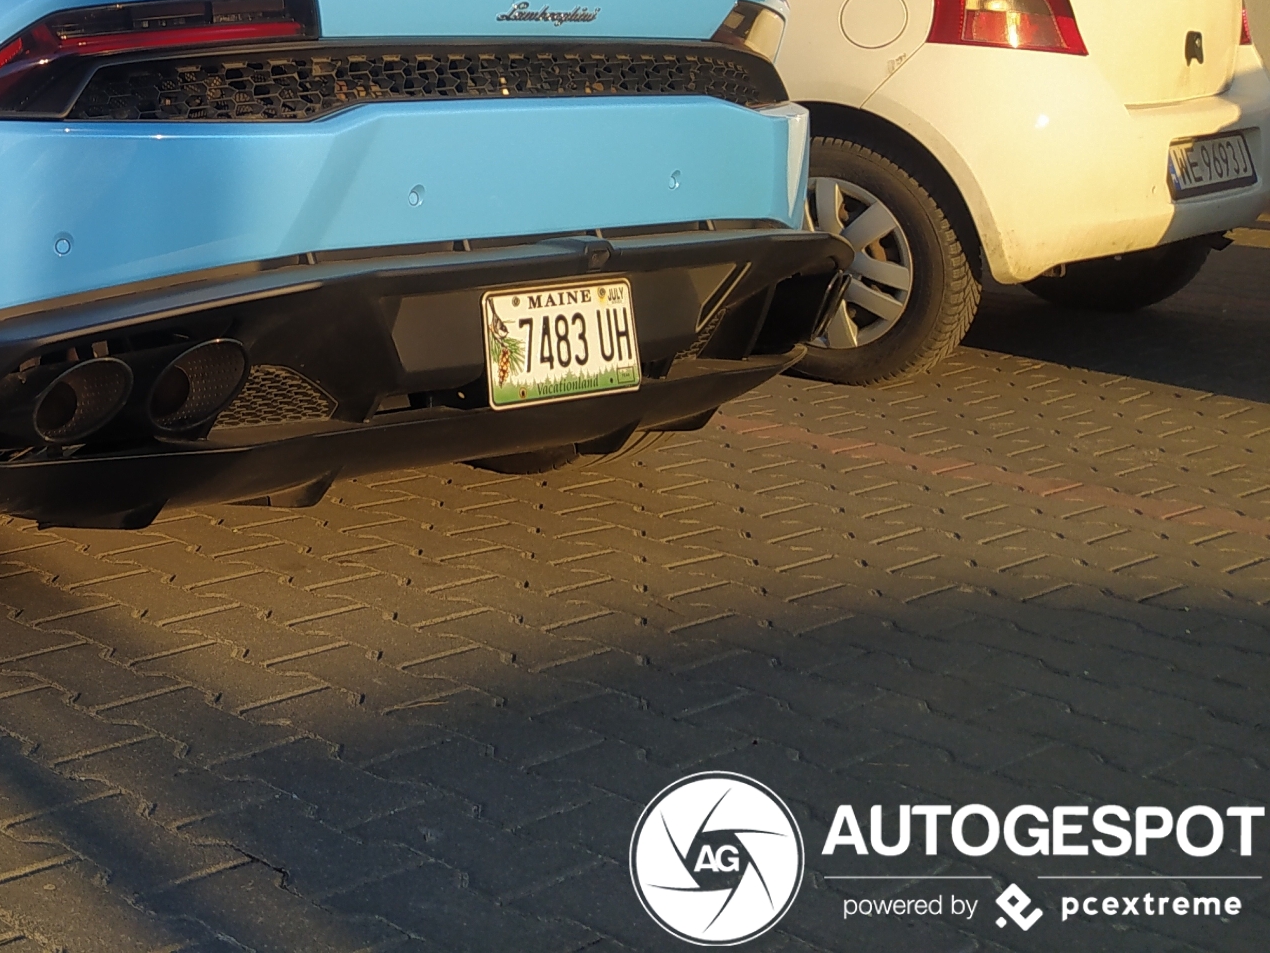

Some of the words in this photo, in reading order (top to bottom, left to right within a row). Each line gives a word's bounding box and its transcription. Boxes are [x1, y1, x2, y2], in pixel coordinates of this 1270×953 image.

[496, 1, 601, 26] Lamborghini
[1173, 146, 1203, 185] WE
[527, 289, 592, 309] MAINE
[607, 287, 624, 301] JULY
[518, 312, 589, 373] 7483
[596, 307, 633, 362] UH
[536, 373, 599, 396] Vacationland
